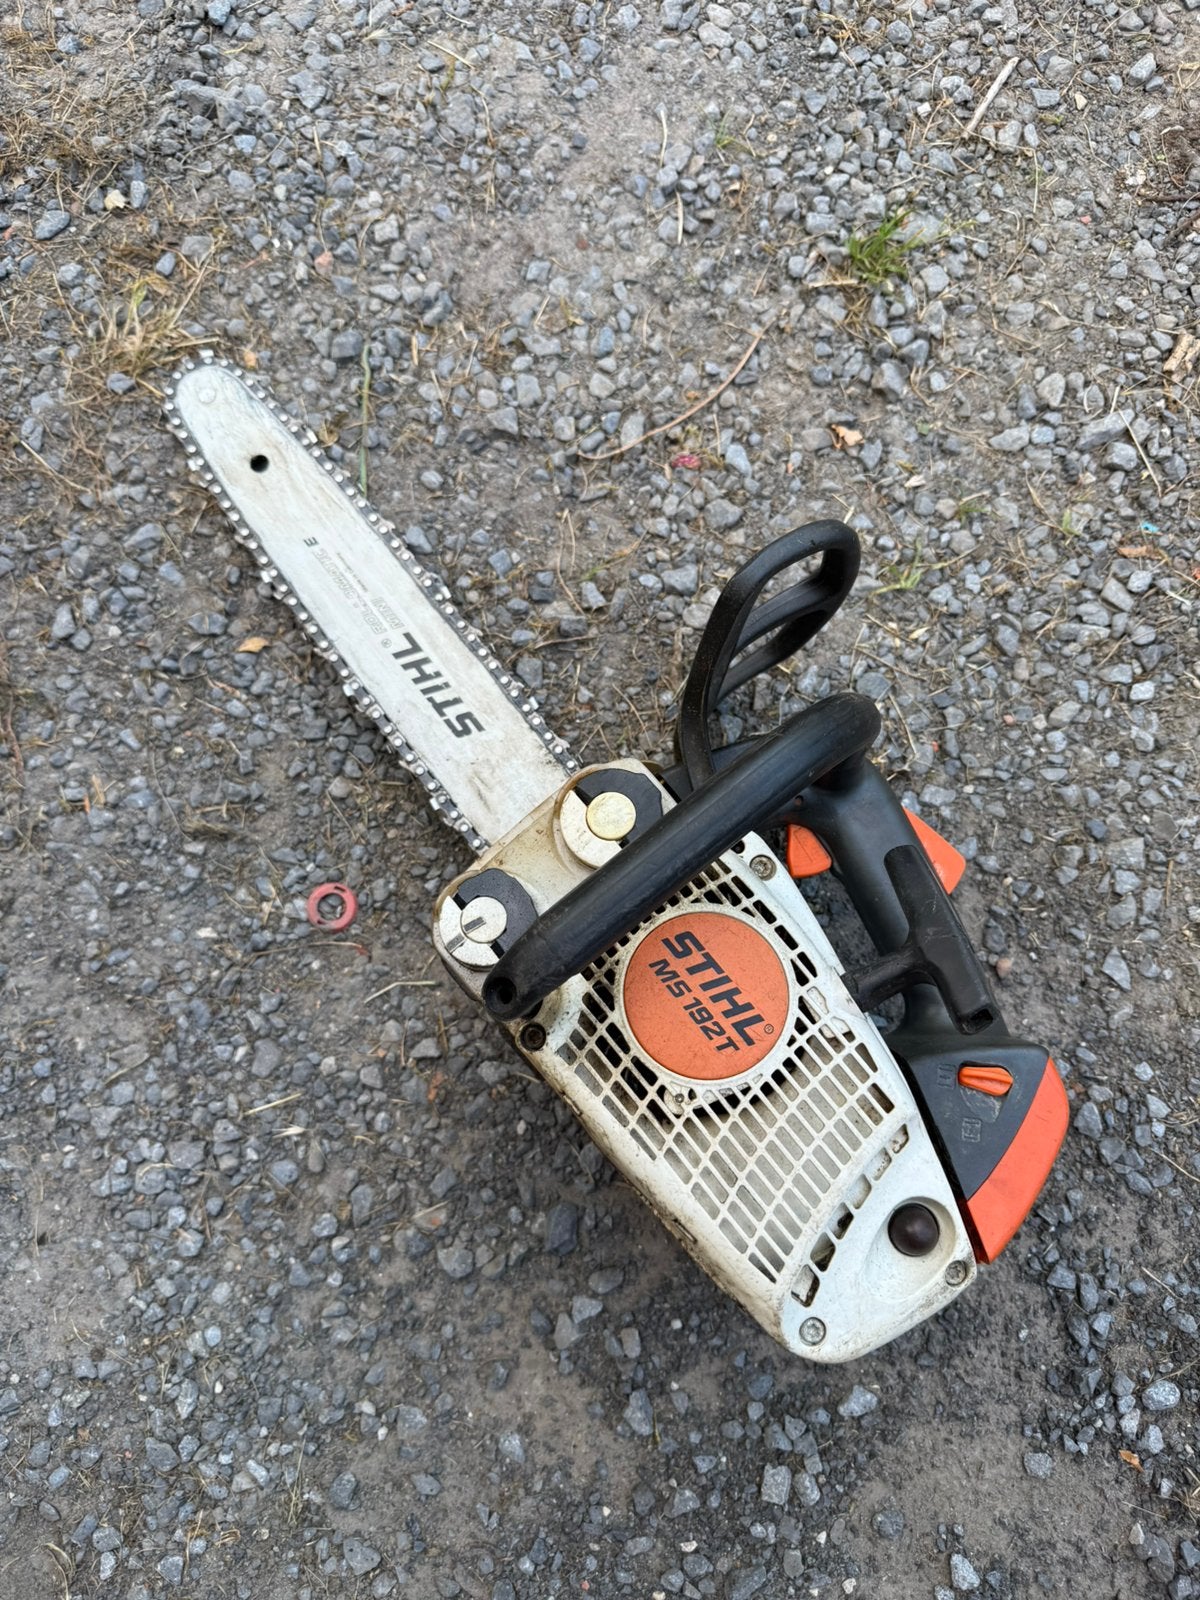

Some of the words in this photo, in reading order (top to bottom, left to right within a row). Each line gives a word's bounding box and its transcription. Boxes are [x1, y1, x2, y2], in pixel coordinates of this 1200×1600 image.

[303, 536, 320, 548] E
[392, 632, 487, 739] STIHL
[648, 958, 693, 998] MS
[661, 931, 765, 1047] STIHL
